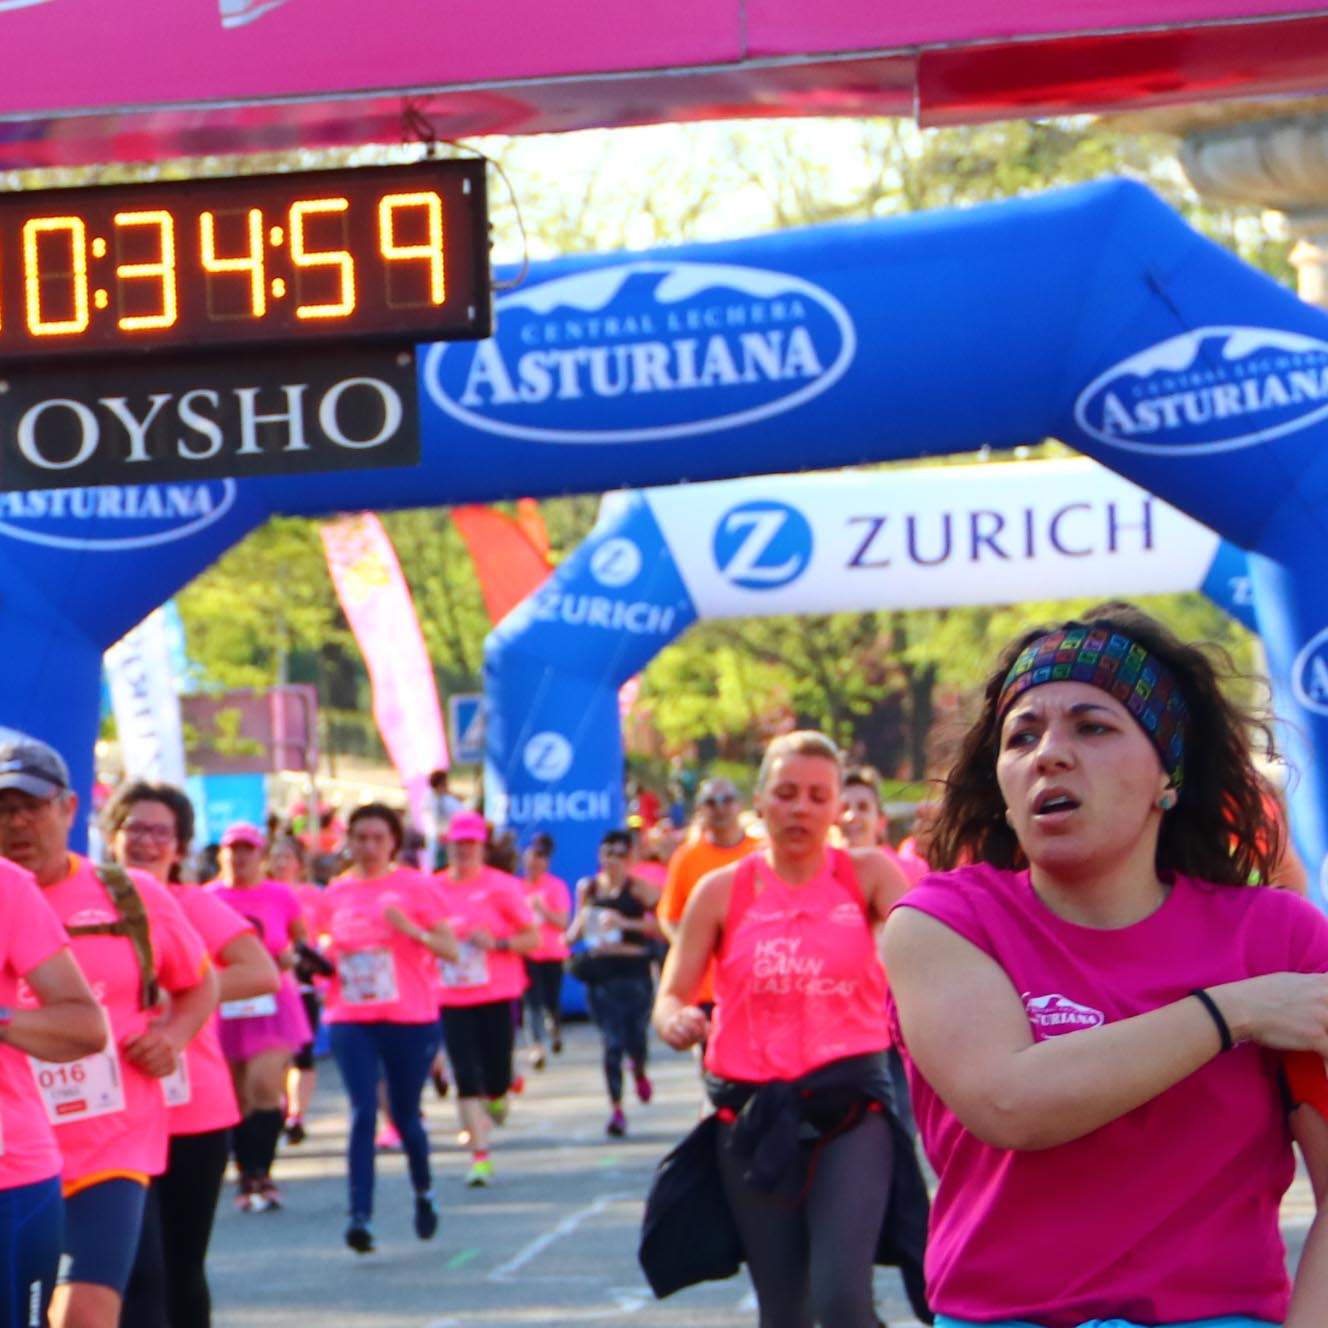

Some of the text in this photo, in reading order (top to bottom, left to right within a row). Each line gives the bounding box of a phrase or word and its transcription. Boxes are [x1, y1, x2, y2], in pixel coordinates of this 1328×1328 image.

[459, 326, 823, 406] ASTURIANA
[1101, 366, 1328, 435] ASTURIAN
[17, 377, 403, 470] OYSHO
[844, 500, 1155, 569] ZURICH
